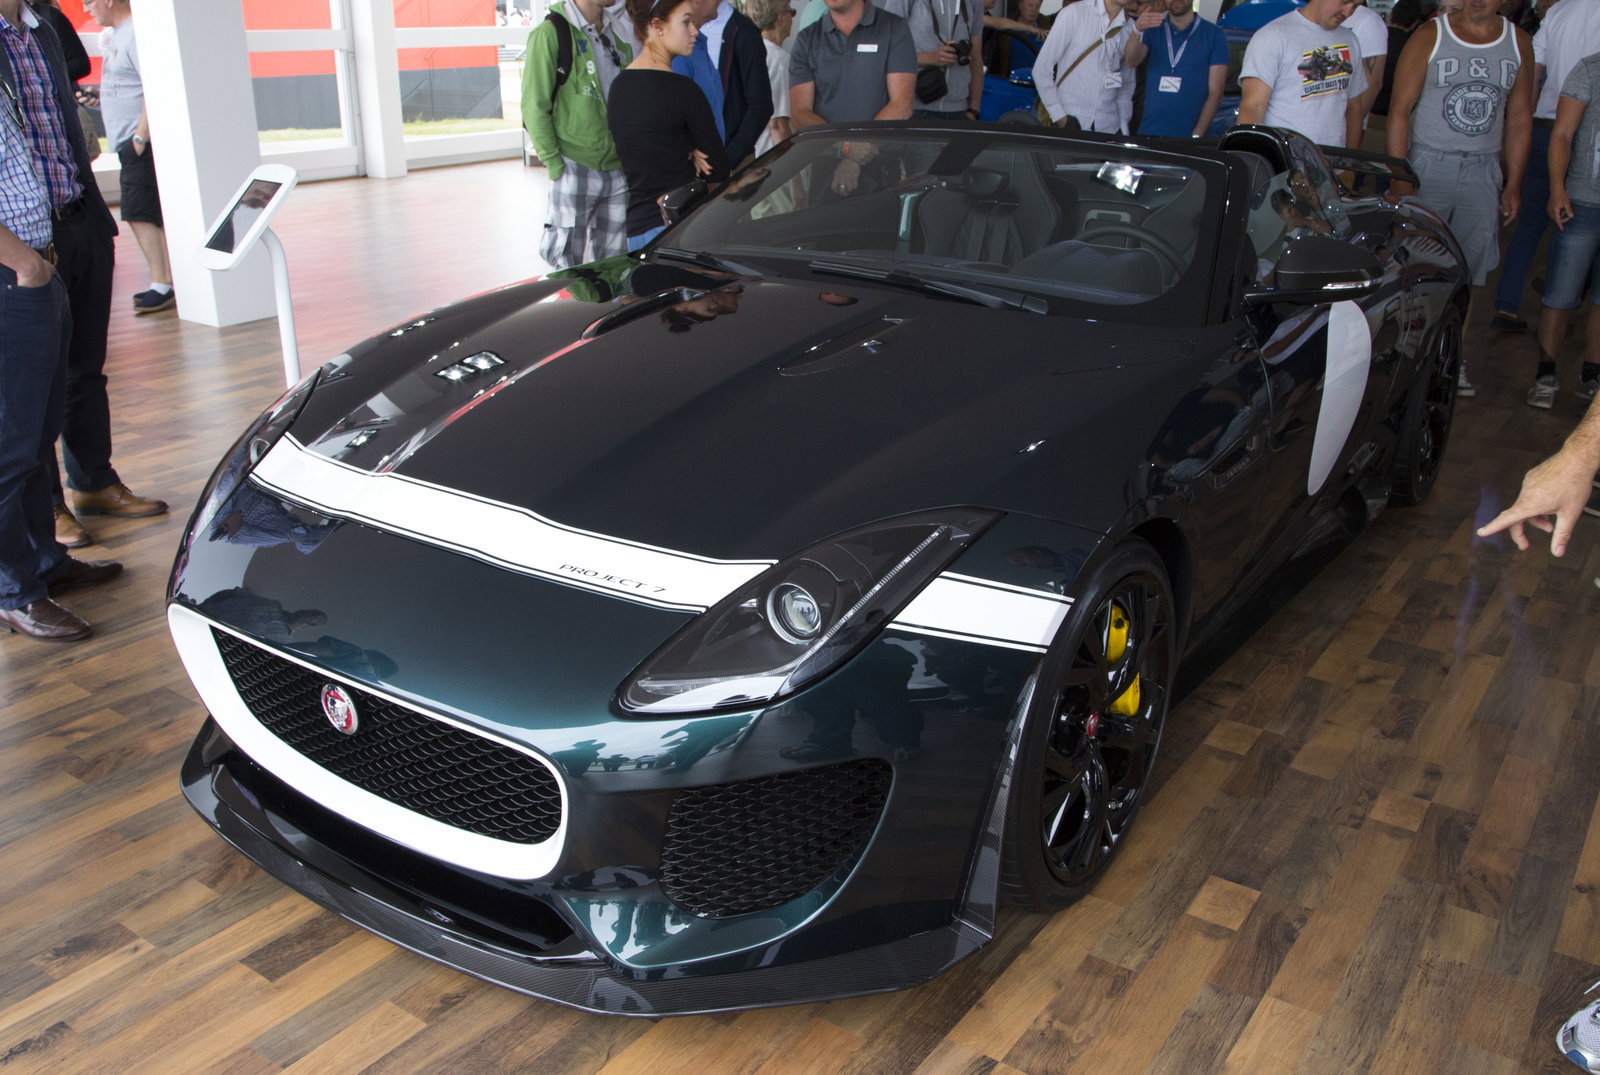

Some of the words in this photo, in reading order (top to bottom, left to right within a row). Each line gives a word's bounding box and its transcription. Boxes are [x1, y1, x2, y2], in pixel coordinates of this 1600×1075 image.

[1436, 57, 1459, 88] P
[1469, 57, 1488, 78] &
[1448, 86, 1470, 106] PRIDE
[559, 564, 648, 589] PROJECT
